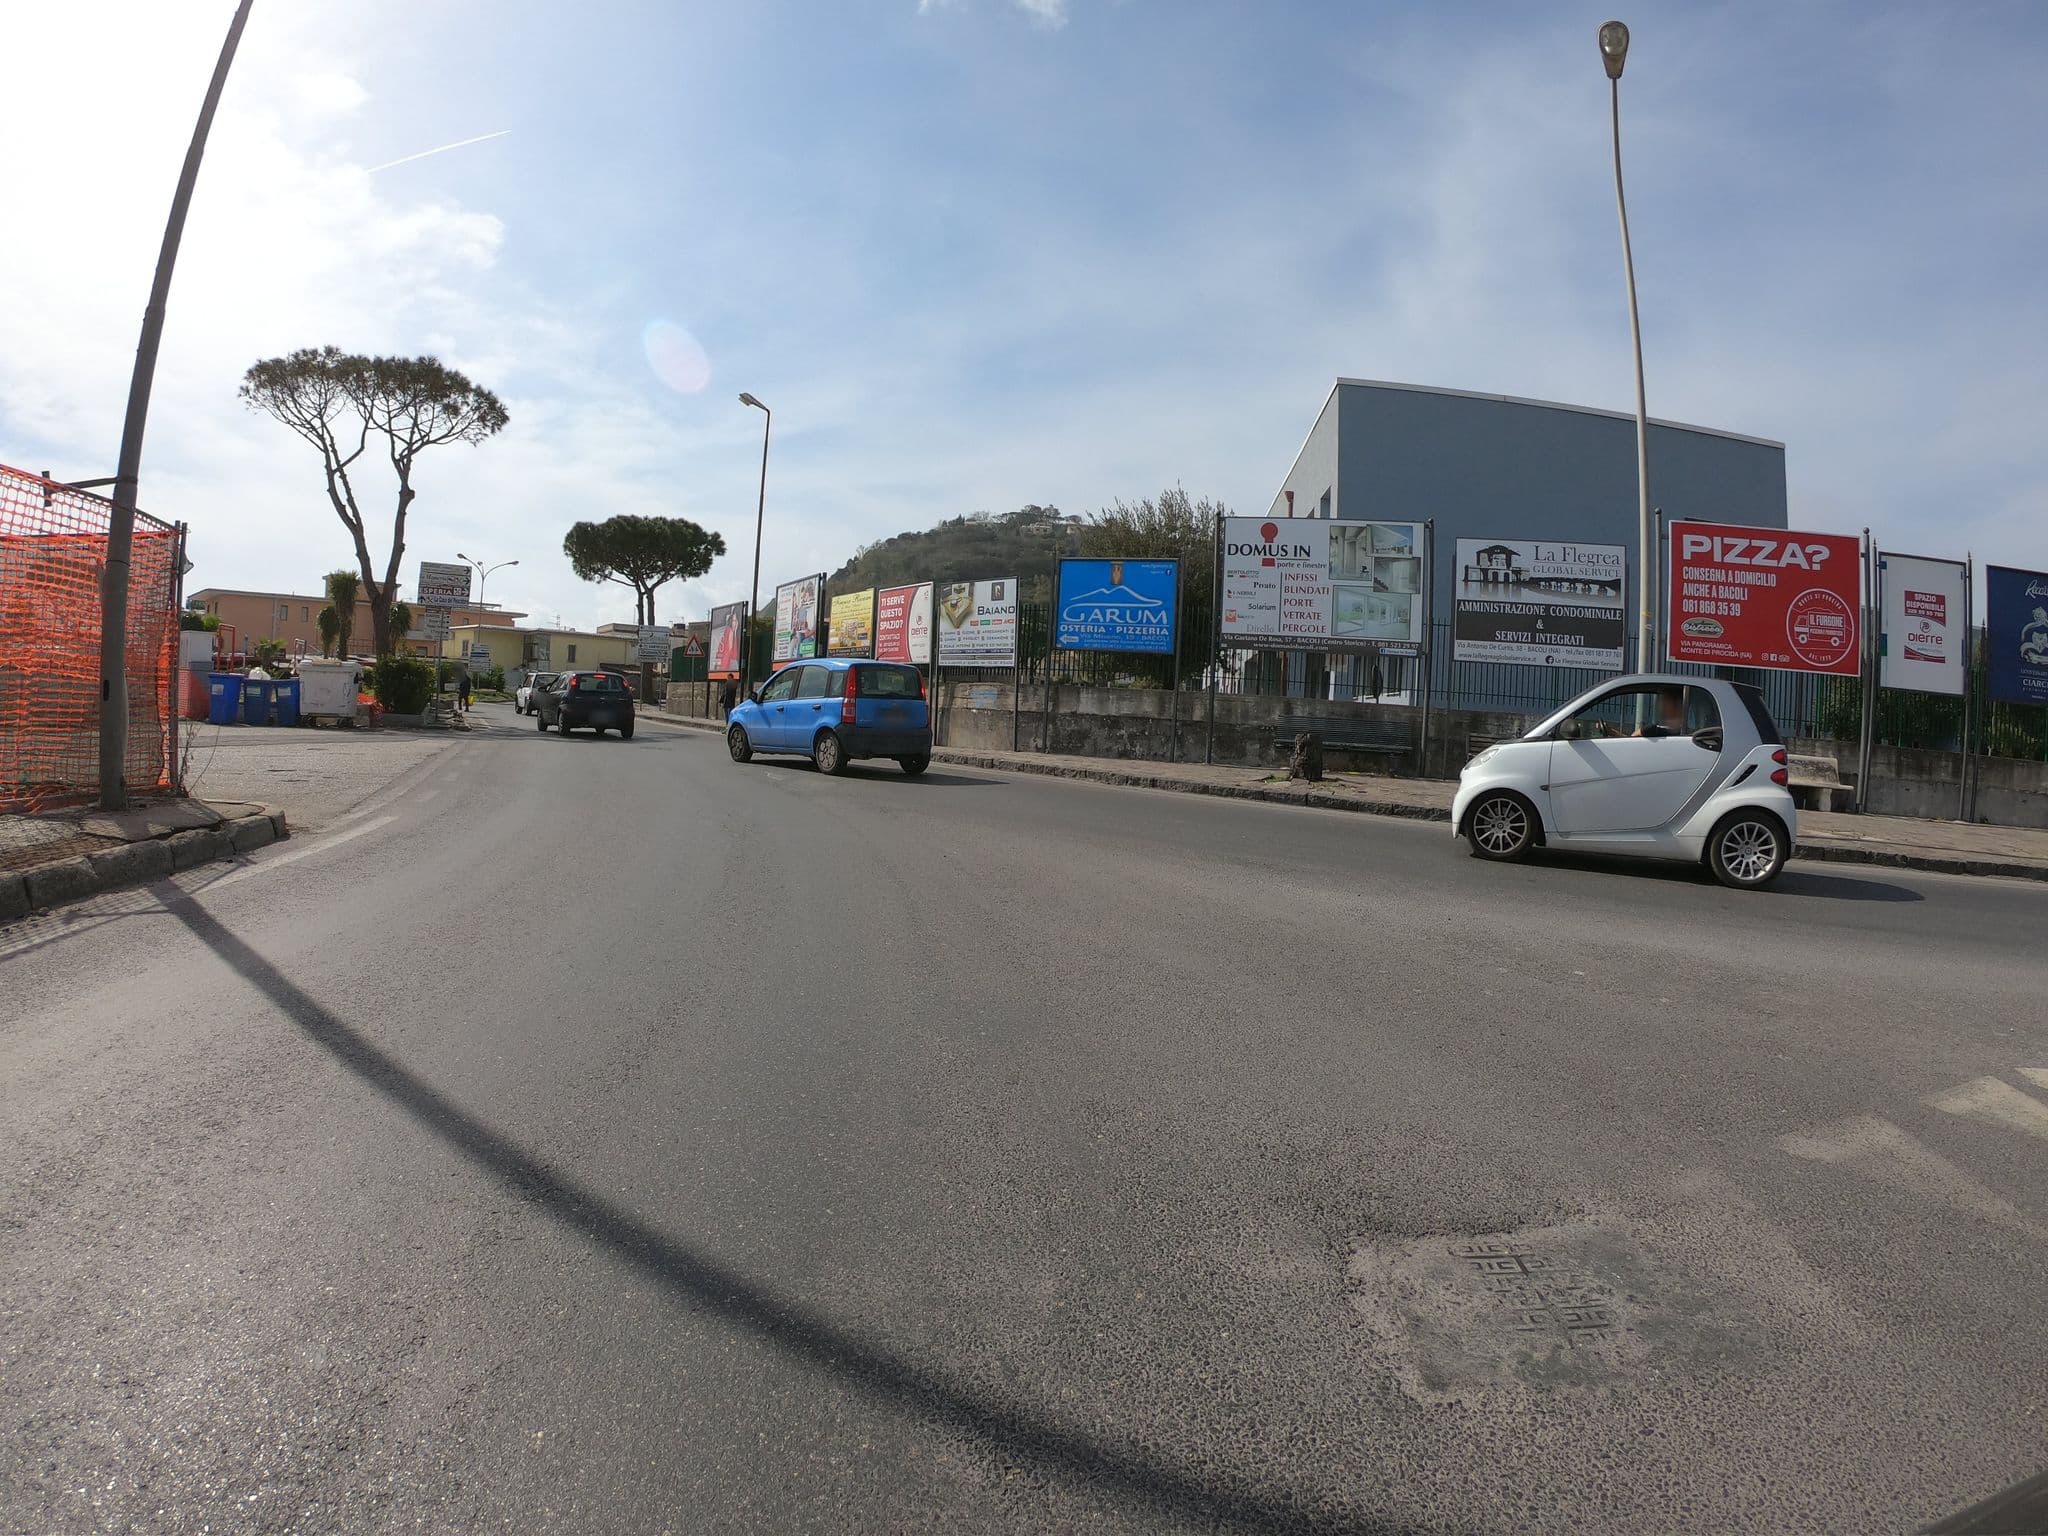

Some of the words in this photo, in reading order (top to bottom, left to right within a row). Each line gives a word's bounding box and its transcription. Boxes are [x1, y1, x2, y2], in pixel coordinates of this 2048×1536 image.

[1227, 543, 1288, 558] DOMUS
[1293, 544, 1311, 558] IN
[1534, 544, 1556, 561] La
[1562, 547, 1620, 566] Flegrea
[1682, 534, 1830, 571] PIZZA?
[1276, 561, 1294, 569] porte
[1302, 561, 1327, 569] finestre
[1284, 573, 1318, 582] INFISSI
[1532, 566, 1576, 576] GLOBAL
[1578, 567, 1621, 578] SERVICE
[1682, 566, 1726, 583] CONSEGNA
[1727, 570, 1733, 583] A
[1734, 571, 1777, 587] DOMICILIO
[1284, 585, 1330, 595] BLINDATI
[1682, 583, 1710, 598] ANCHE
[1711, 585, 1717, 598] A
[1718, 587, 1748, 601] BACOLI
[886, 595, 905, 606] SERVE
[1283, 598, 1313, 608] PORTE
[1914, 593, 1937, 603] SPAZIO
[1248, 602, 1277, 611] Solarium
[1458, 601, 1546, 616] AMMINISTRAZIONE
[1550, 606, 1622, 621] CONDOMINIALE
[1682, 599, 1698, 613] 081
[1699, 600, 1715, 615] 868
[1717, 601, 1728, 616] 35
[1729, 602, 1741, 617] 39
[1906, 600, 1945, 612] DISPONIBILE
[880, 607, 903, 619] QUESTO
[1063, 604, 1168, 625] GARUM
[1283, 611, 1322, 621] VETRATE
[879, 619, 904, 631] SPAZIO?
[1536, 619, 1544, 629] &
[1809, 614, 1815, 626] IL
[1816, 615, 1843, 628] FURGONE
[1060, 625, 1106, 633] OSTERIA
[1116, 626, 1169, 636] PIZZERIA
[1282, 623, 1327, 634] PERGOLE
[1495, 630, 1531, 643] SERVIZI
[1535, 632, 1584, 646] INTEGRATI
[1680, 639, 1691, 647] VIA
[1691, 640, 1733, 651] PANORAMICA
[1680, 647, 1703, 655] MONTE
[1711, 649, 1739, 658] PROCIDA
[2023, 678, 2048, 689] CIARC
